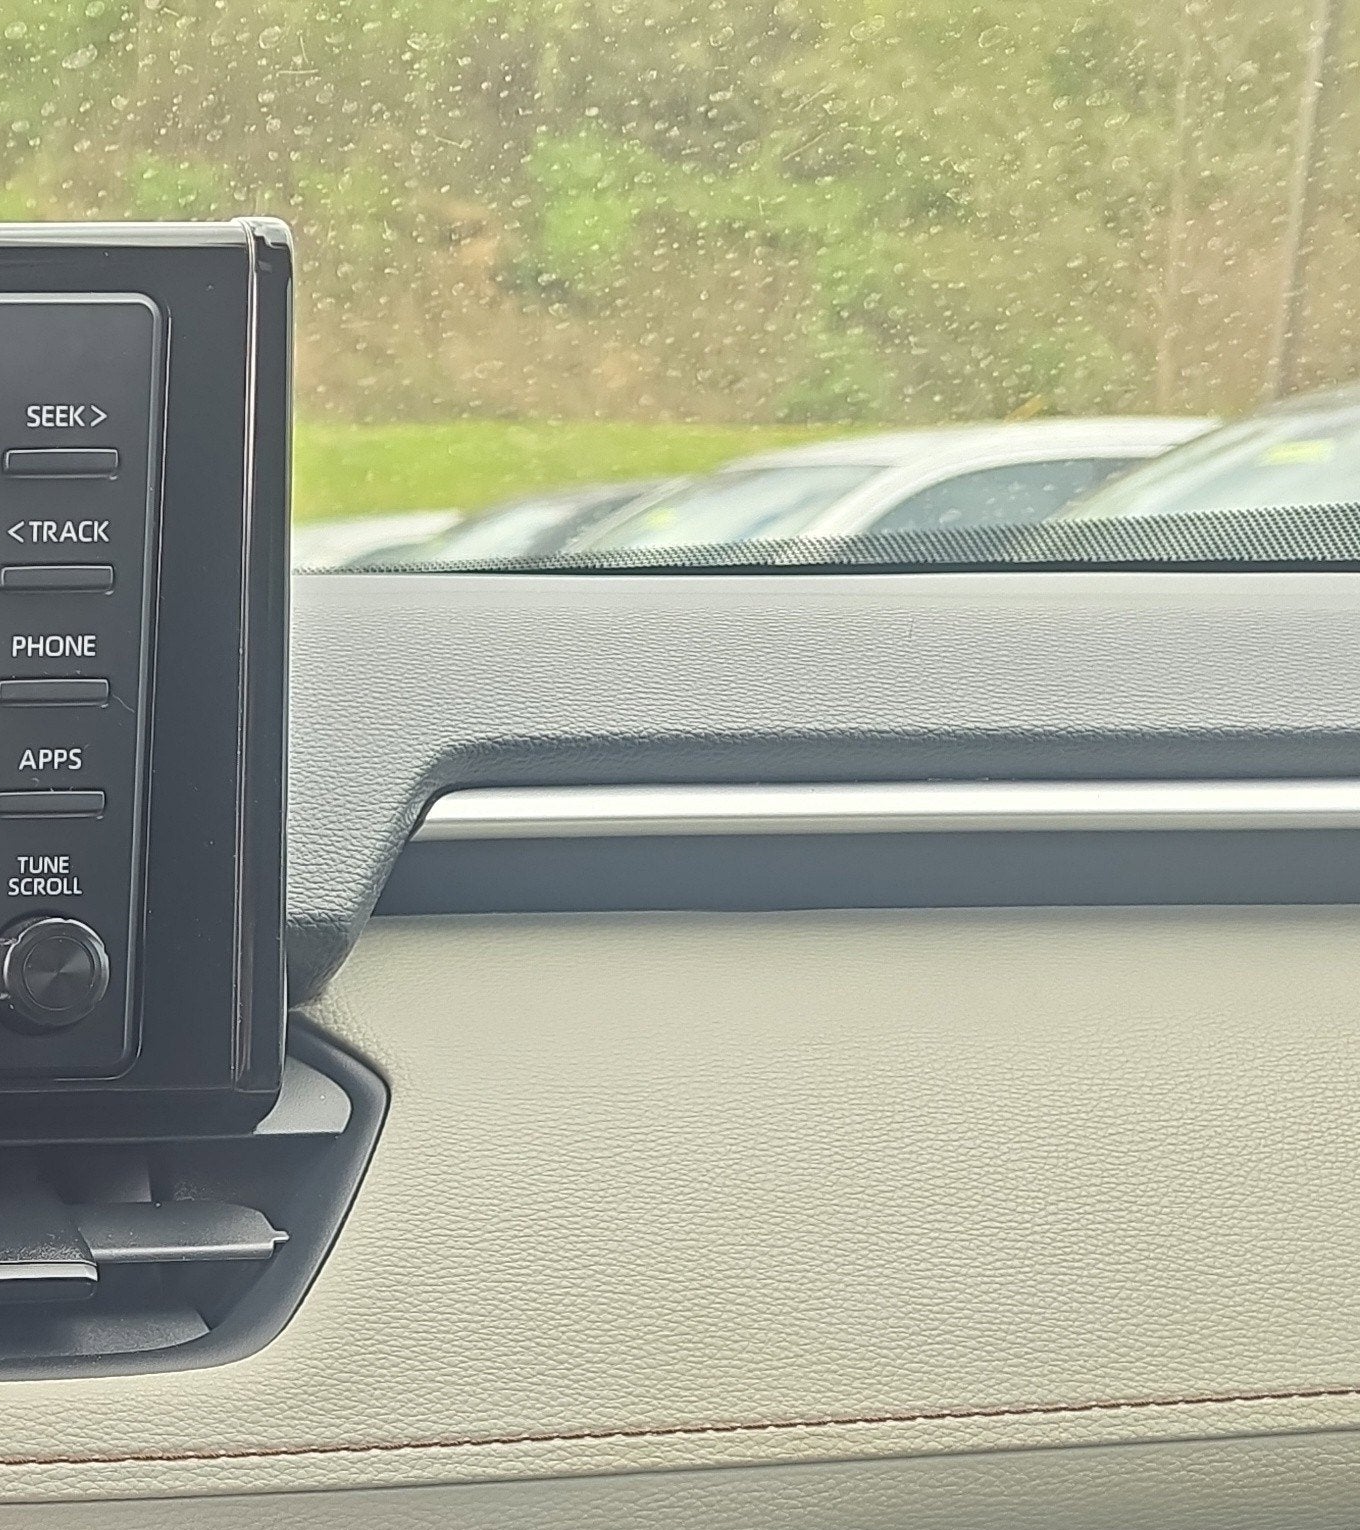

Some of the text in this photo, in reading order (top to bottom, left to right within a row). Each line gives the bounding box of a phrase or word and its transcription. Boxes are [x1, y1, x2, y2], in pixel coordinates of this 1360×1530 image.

[26, 405, 85, 428] SEEK
[28, 520, 109, 543] TRACK
[12, 635, 96, 657] PHONE
[18, 748, 82, 770] APPS
[17, 856, 70, 874] TUNE
[7, 876, 83, 896] SCROLL
